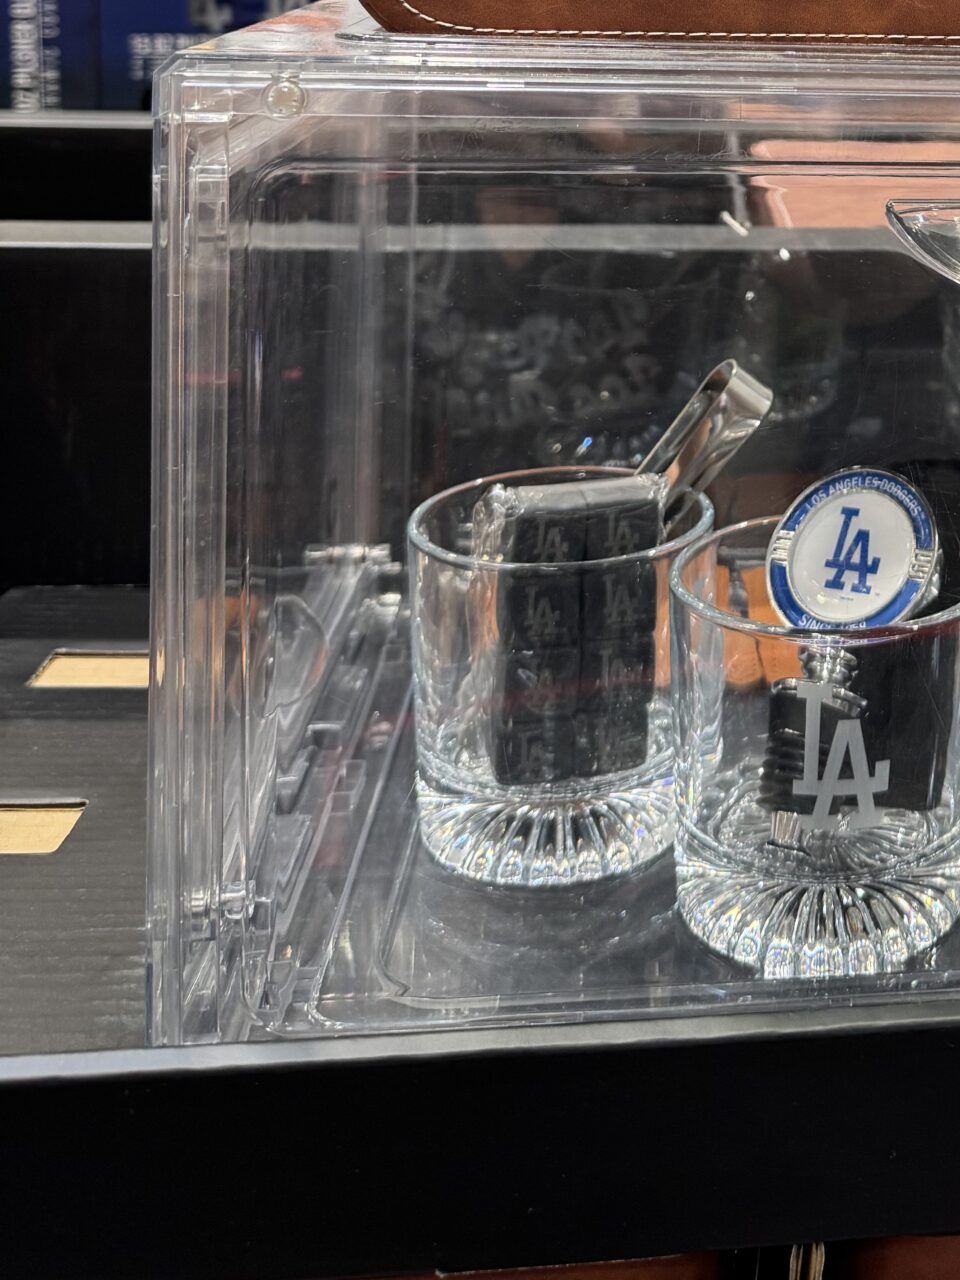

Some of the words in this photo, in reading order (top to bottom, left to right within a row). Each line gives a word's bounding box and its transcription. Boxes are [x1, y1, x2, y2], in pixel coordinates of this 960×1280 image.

[828, 476, 879, 495] ANGELES
[824, 506, 881, 594] LA
[792, 682, 891, 832] LA
